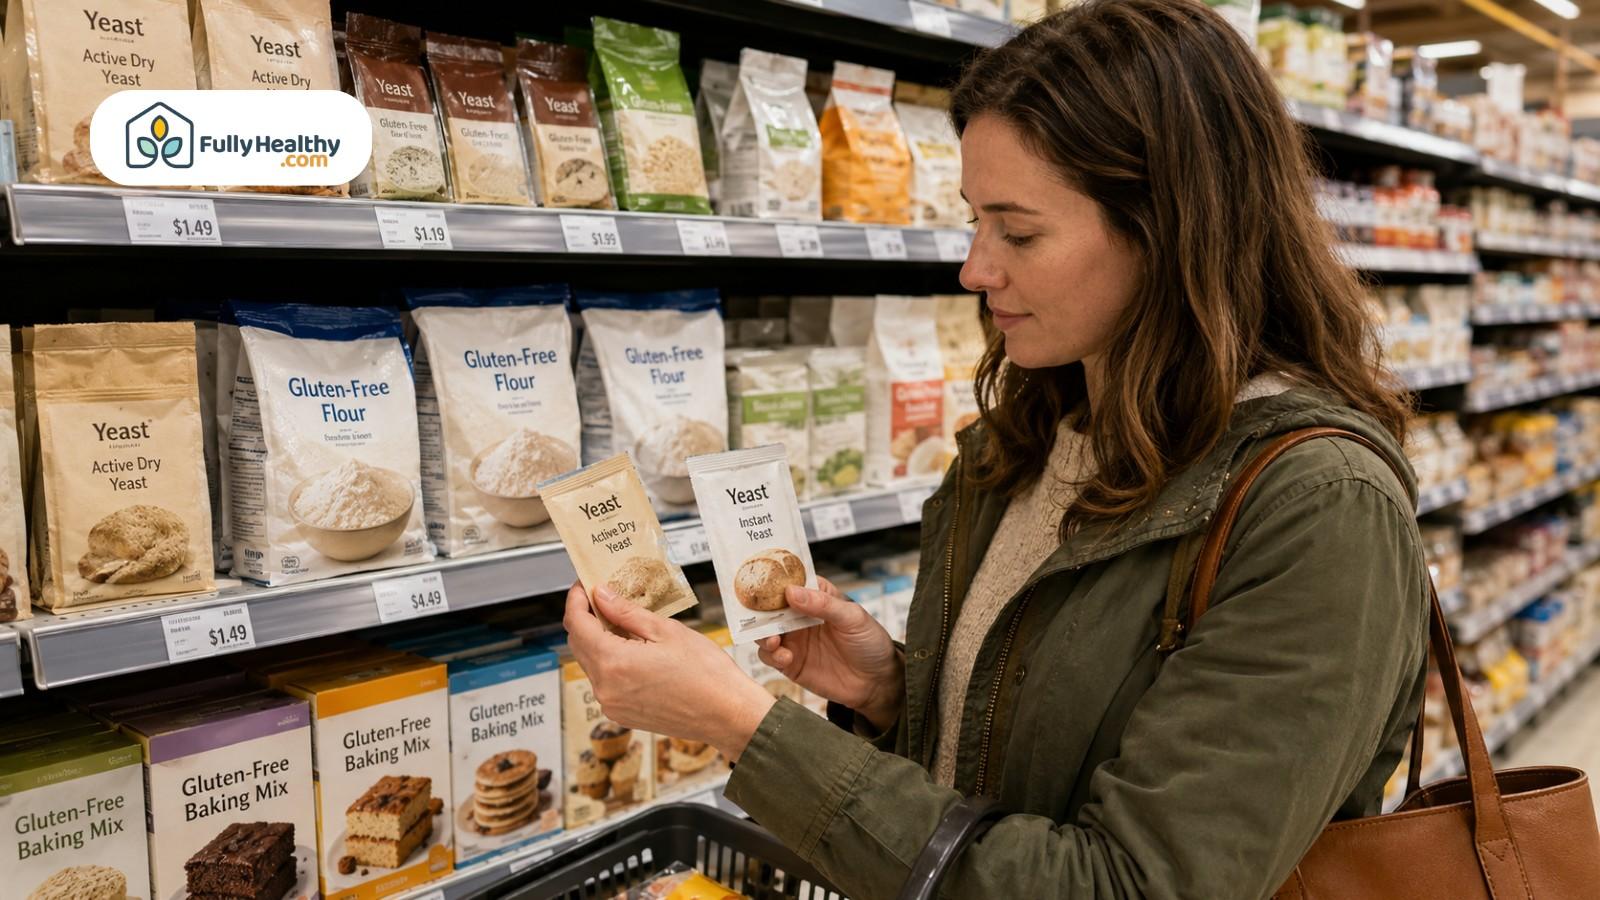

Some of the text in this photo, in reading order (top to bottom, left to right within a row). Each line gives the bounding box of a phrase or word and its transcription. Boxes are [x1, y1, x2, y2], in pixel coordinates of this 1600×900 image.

[83, 10, 144, 36] Yeast
[250, 35, 302, 58] Yeast
[83, 49, 155, 72] Active Dry
[102, 70, 142, 87] Yeast
[251, 70, 311, 90] Active Dry
[376, 79, 414, 98] Yeast
[458, 92, 495, 109] Yeast
[544, 97, 580, 114] Yeast
[172, 219, 213, 237] $1.49
[414, 226, 445, 242] $1.19
[591, 233, 617, 246] $1.99
[464, 347, 557, 369] Gluten-Free
[625, 345, 704, 364] Gluten-Free
[494, 373, 535, 392] Flour
[650, 368, 686, 385] Flour
[288, 377, 390, 398] Gluten-Free
[321, 403, 366, 423] Flour
[93, 420, 150, 442] Yeast
[91, 456, 161, 474] Active Dry
[109, 476, 148, 492] Yeast
[726, 484, 769, 505] Yeast
[579, 494, 622, 521] Yeast
[738, 513, 773, 529] Instant
[591, 519, 637, 544] Active Dry
[747, 528, 773, 542] Yeast
[606, 537, 633, 554] Yeast
[411, 590, 441, 610] $4.49
[209, 624, 247, 646] $1.49
[469, 692, 546, 722] Gluten-Free
[343, 715, 431, 750] Gluten-Free
[471, 712, 544, 743] Baking Mix
[345, 737, 431, 773] Baking Mix
[182, 759, 290, 797] Gluten-Free
[184, 780, 289, 822] Baking Mix
[15, 795, 125, 835] Gluten-Free
[18, 817, 124, 861] Baking Mix
